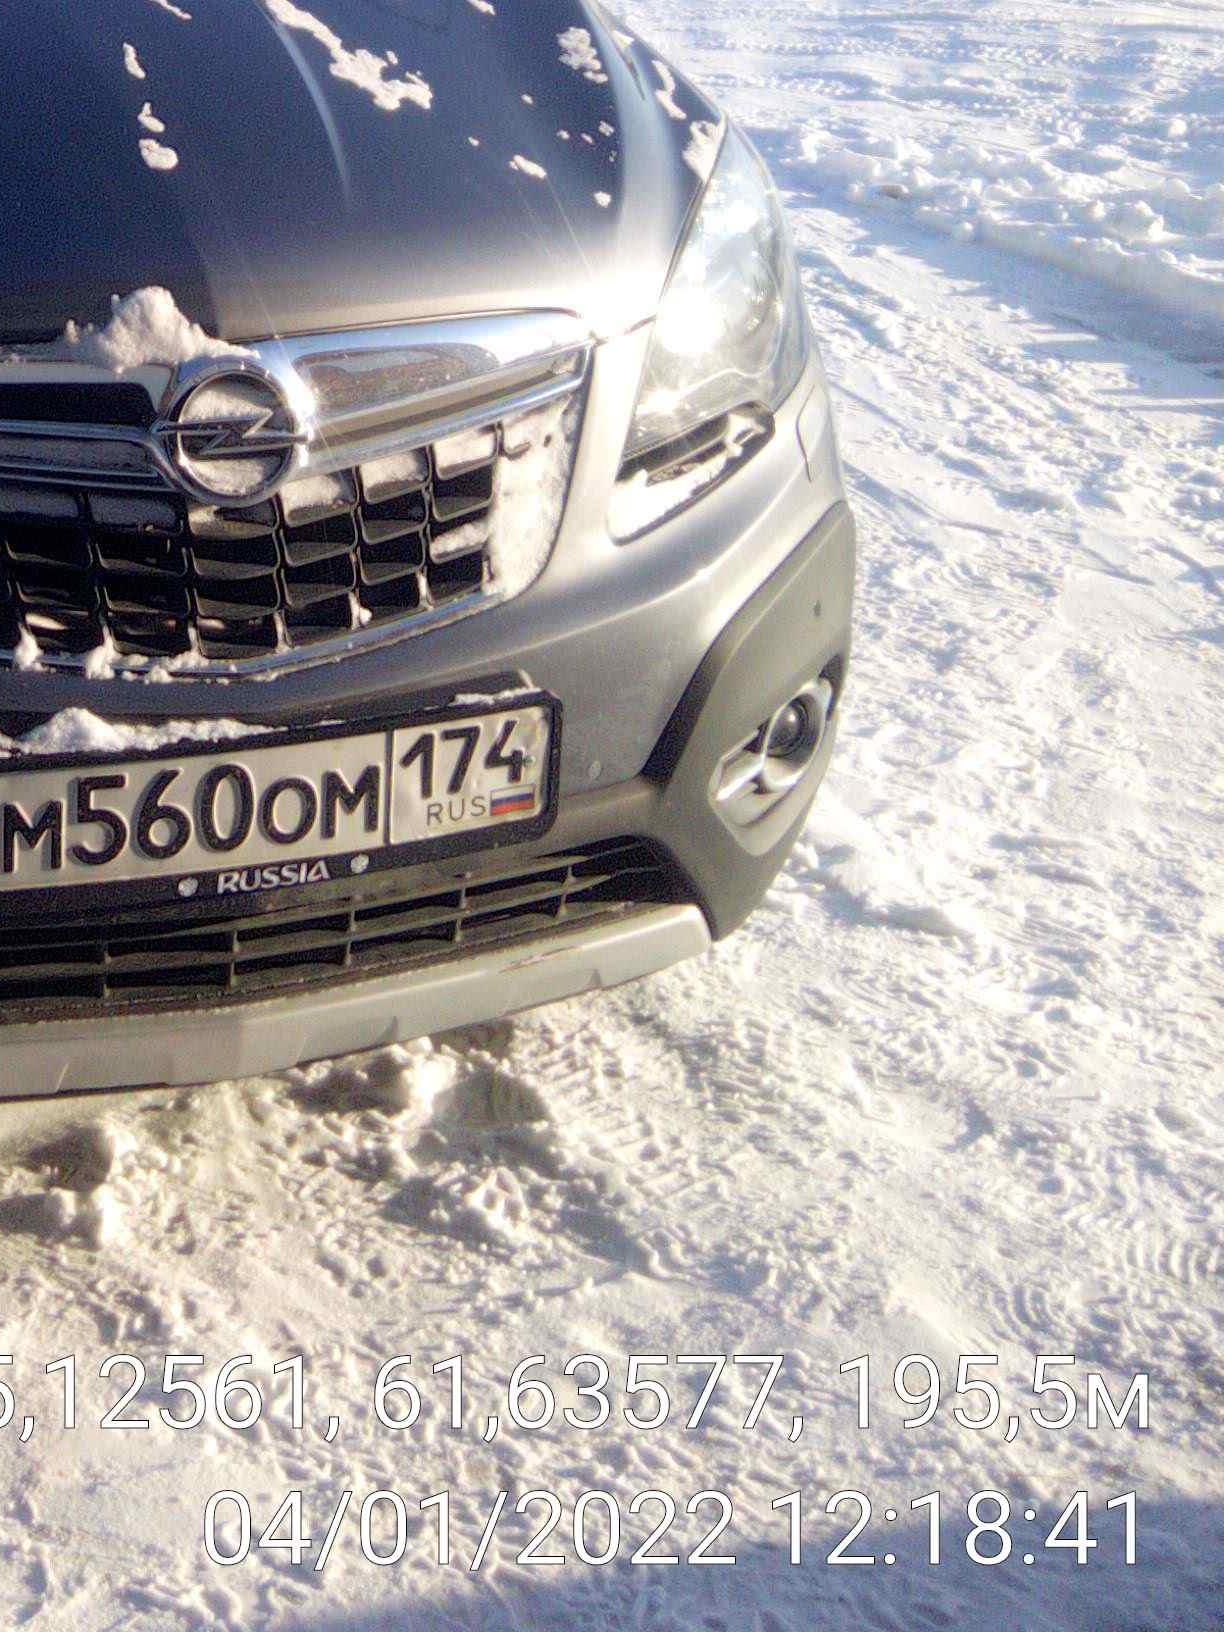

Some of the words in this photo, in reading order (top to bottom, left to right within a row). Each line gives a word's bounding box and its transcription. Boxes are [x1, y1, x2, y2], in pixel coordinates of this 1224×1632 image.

[399, 718, 524, 800] 174
[425, 794, 488, 827] RUS
[215, 859, 330, 895] RUSSIA
